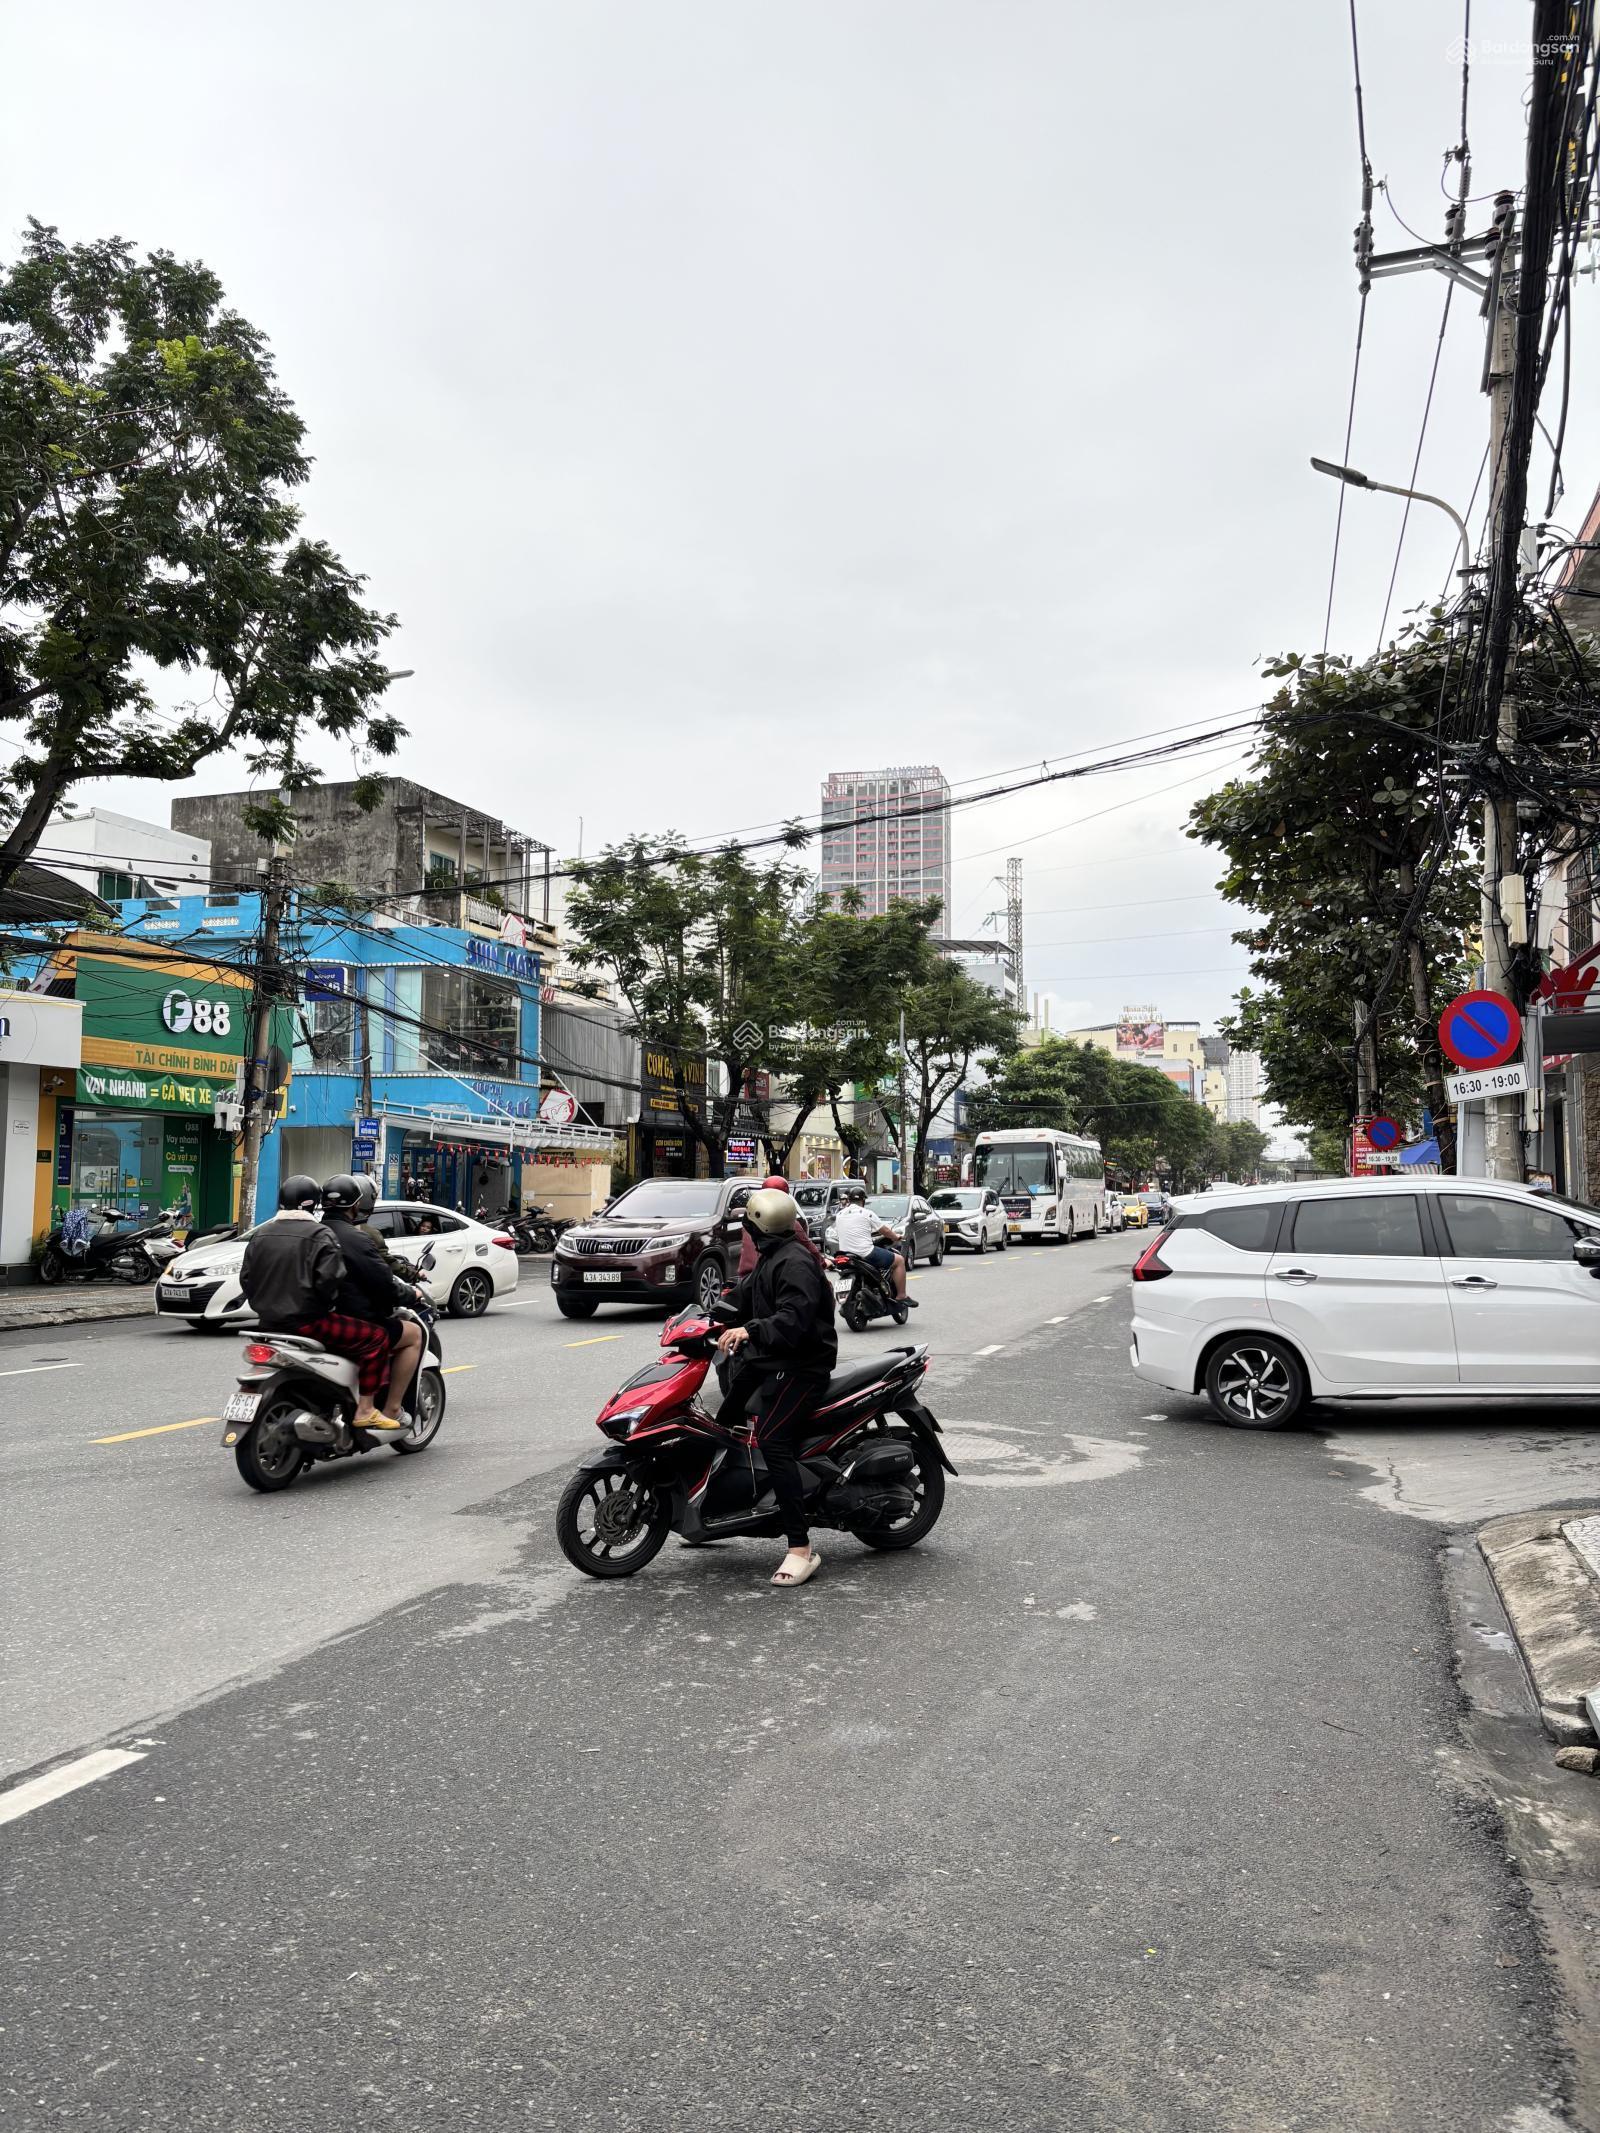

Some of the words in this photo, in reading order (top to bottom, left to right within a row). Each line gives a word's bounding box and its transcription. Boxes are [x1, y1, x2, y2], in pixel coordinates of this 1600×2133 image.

[136, 1050, 155, 1065] TÀI
[158, 1051, 190, 1070] CHÍNH
[193, 1055, 217, 1073] BÌNH
[85, 1076, 105, 1095] VAY
[109, 1079, 147, 1099] NHANH
[199, 1088, 212, 1104] XE
[1453, 1079, 1482, 1095] 16:30
[1491, 1072, 1520, 1089] 19:00
